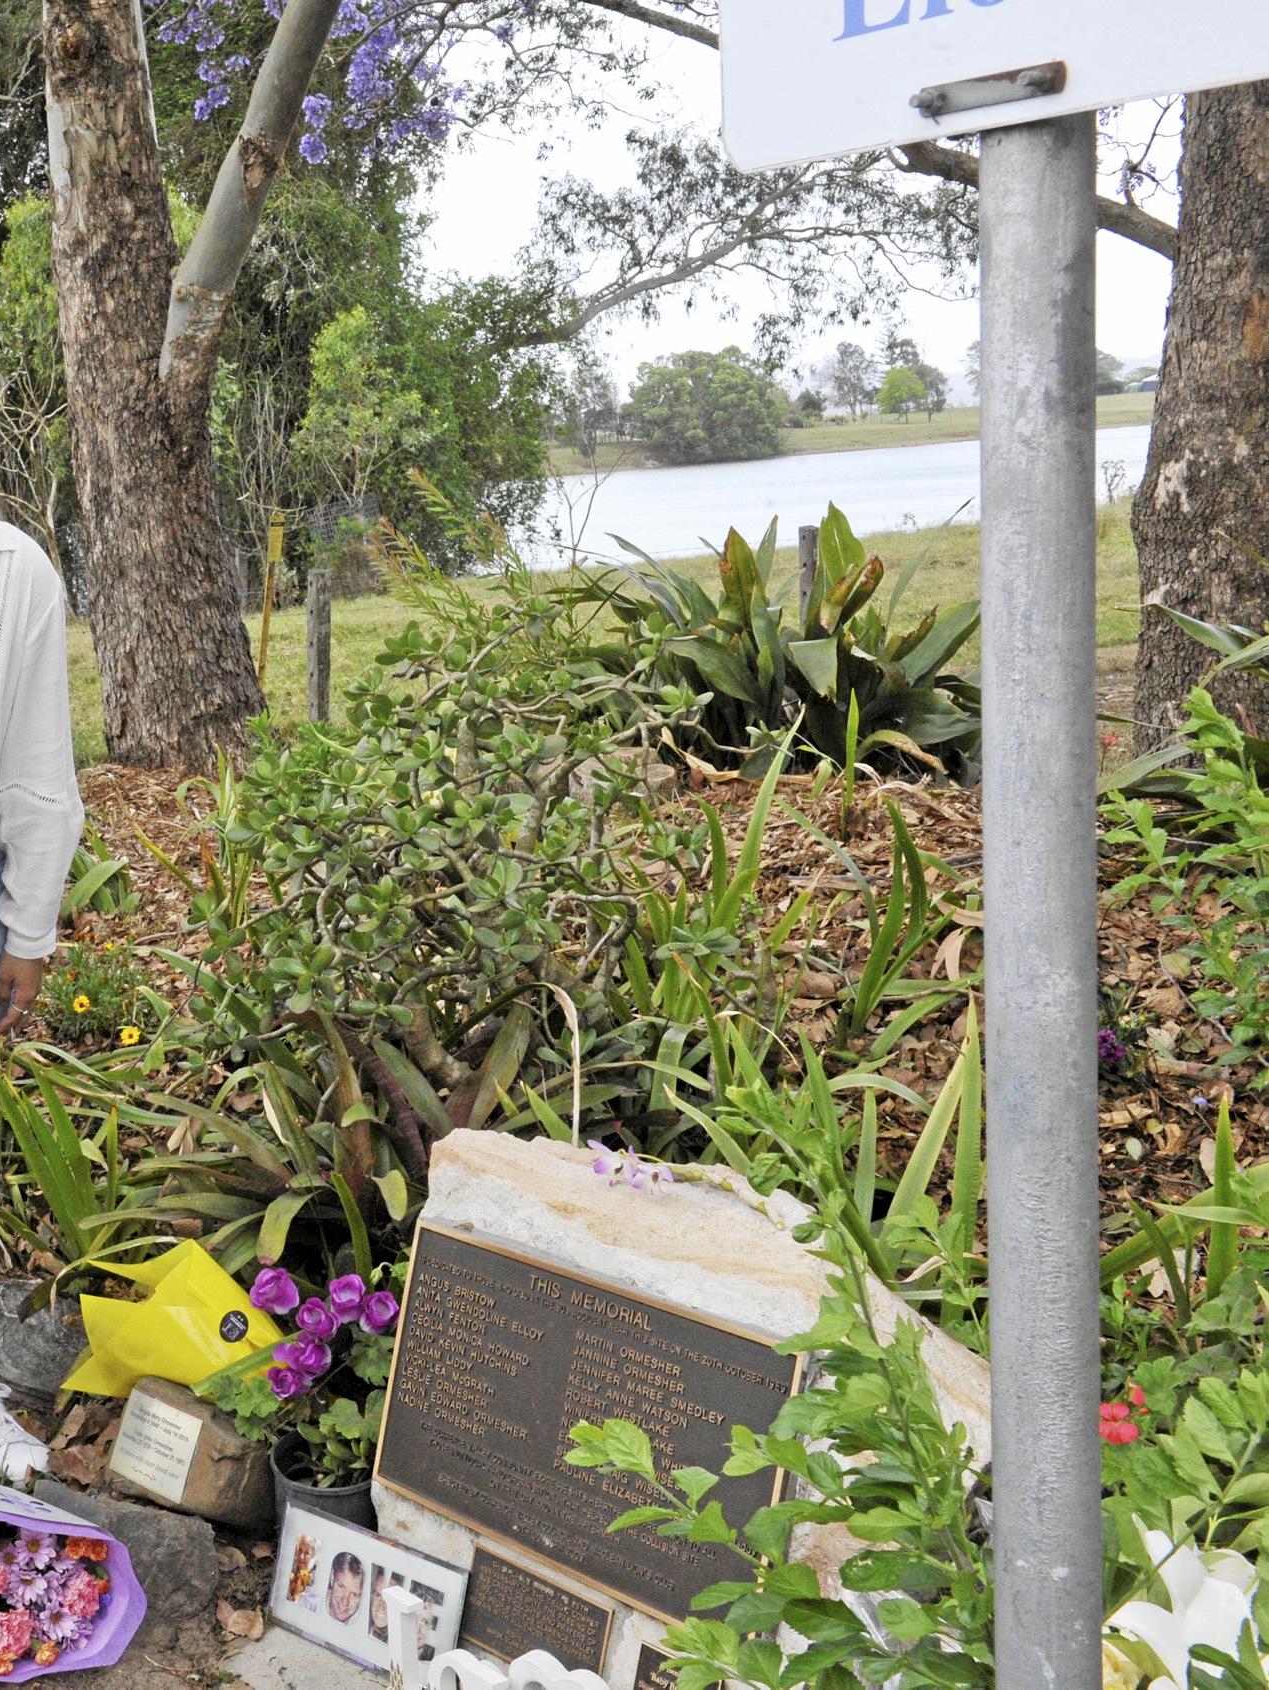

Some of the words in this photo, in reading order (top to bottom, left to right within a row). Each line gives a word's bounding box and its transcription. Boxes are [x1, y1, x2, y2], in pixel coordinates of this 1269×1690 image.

[419, 1272, 450, 1293] ANGUS
[454, 1285, 496, 1309] BRISTOW
[528, 1274, 562, 1300] THIS
[571, 1290, 654, 1332] MEMORIAL
[414, 1299, 444, 1318] ALWYN
[448, 1312, 486, 1335] FENTON
[416, 1286, 441, 1303] ANITA
[446, 1297, 507, 1328] GWENDOLINE
[512, 1322, 544, 1343] ELLOY
[406, 1339, 441, 1361] WILLIAM
[446, 1355, 473, 1374] LIDDY
[409, 1326, 433, 1343] DAVID
[439, 1337, 466, 1356] KEVIN
[470, 1350, 518, 1377] HUTCHINS
[411, 1312, 444, 1333] CECILIA
[448, 1326, 483, 1348] MONICA
[488, 1342, 530, 1367] HOWARD
[576, 1331, 614, 1353] MARTIN
[620, 1347, 681, 1378] ORMESHER
[650, 1337, 668, 1352] SITE
[670, 1344, 681, 1357] ON
[684, 1349, 699, 1363] THE
[701, 1355, 722, 1371] 20TH
[724, 1363, 763, 1386] OCTOBER
[402, 1365, 431, 1385] LESLIE
[435, 1379, 488, 1409] ORMESHER
[404, 1352, 446, 1377] VICKI-LEA
[451, 1372, 495, 1398] McGRATH
[571, 1360, 621, 1387] JENNIFER
[627, 1381, 664, 1404] MAREE
[670, 1397, 724, 1428] SMEDLEY
[573, 1345, 618, 1370] JANNINE
[623, 1363, 685, 1396] ORMESHER
[397, 1391, 429, 1413] NADINE
[434, 1408, 486, 1438] ORMESHER
[399, 1378, 426, 1398] GAVIN
[431, 1392, 469, 1416] EDWARD
[473, 1410, 527, 1441] ORMESHER
[563, 1403, 605, 1428] WINIFRE
[565, 1388, 607, 1413] ROBERT
[613, 1407, 670, 1438] WESTLAKE
[568, 1374, 601, 1395] KELLY
[606, 1389, 635, 1409] ANNE
[642, 1402, 688, 1430] WATSON
[554, 1460, 595, 1486] PAULINE
[625, 1527, 638, 1540] THE
[640, 1533, 679, 1558] COLLISION
[681, 1551, 700, 1568] SITE
[690, 1542, 699, 1553] TO
[702, 1546, 718, 1561] ALL
